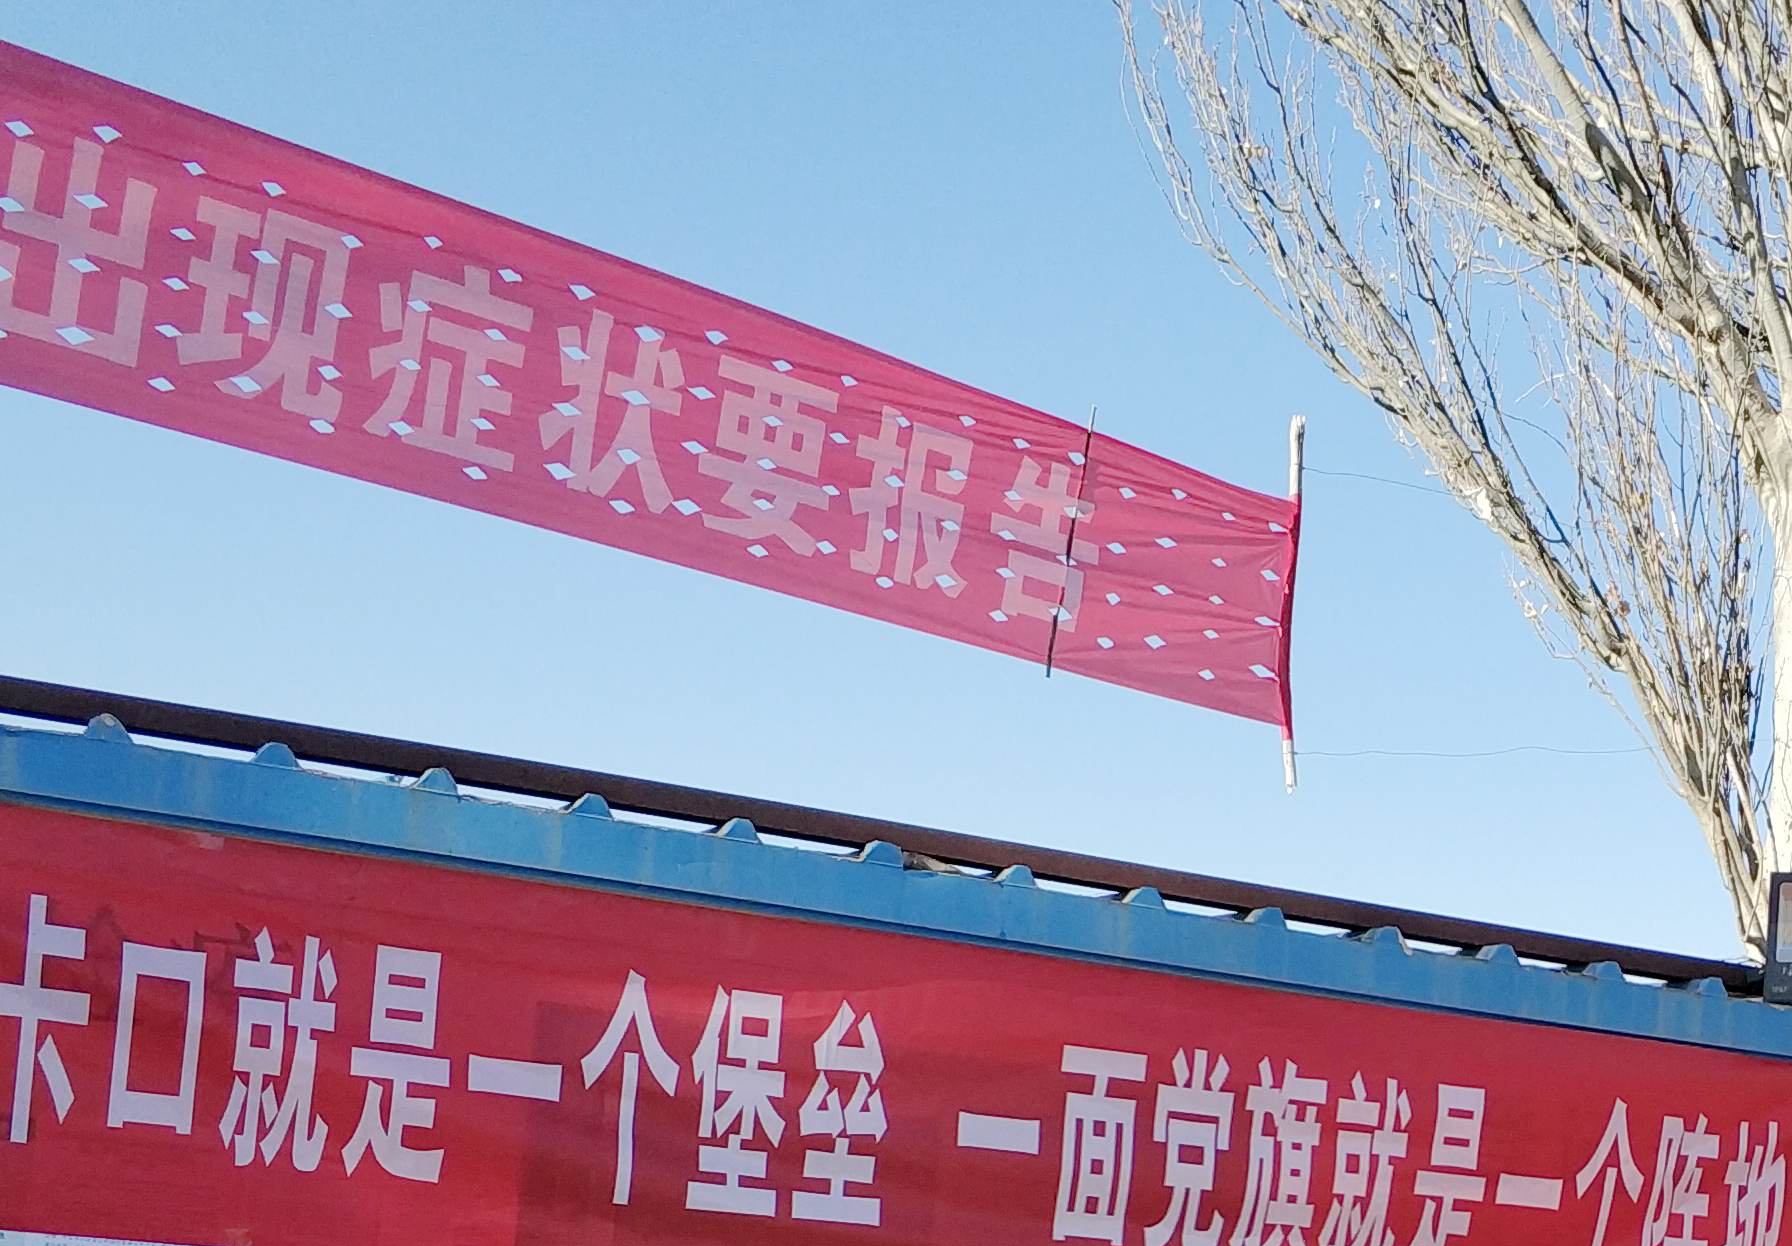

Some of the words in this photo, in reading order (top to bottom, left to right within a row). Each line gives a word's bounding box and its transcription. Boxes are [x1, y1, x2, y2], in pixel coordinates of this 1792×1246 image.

[0, 136, 1098, 633] 出现症状要报告
[0, 893, 890, 1227] 卡口就是一个堡垒
